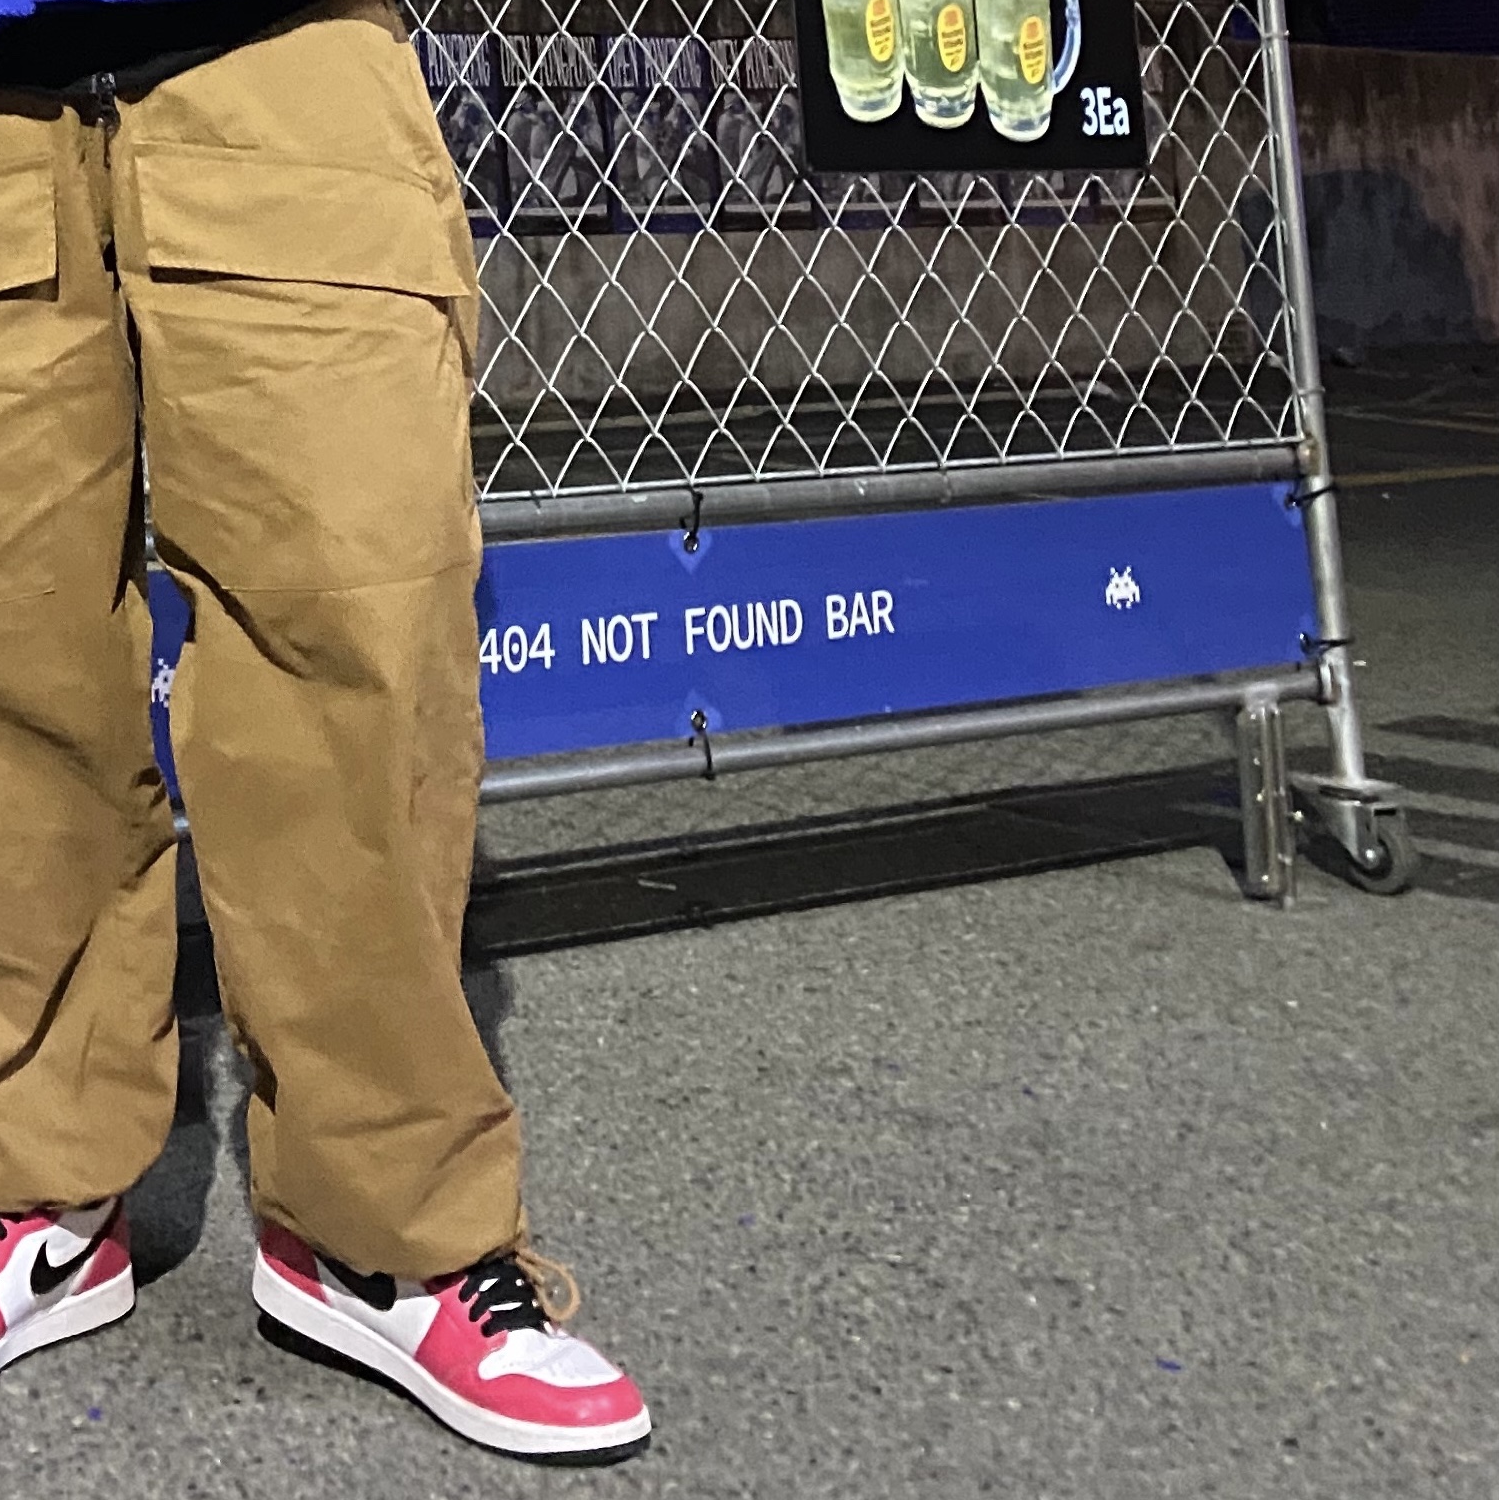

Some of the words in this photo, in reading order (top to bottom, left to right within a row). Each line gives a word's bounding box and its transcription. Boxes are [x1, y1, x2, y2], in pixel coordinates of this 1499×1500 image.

[1080, 87, 1131, 136] 3Ea
[479, 622, 556, 675] 404
[581, 612, 658, 666] NOT
[685, 599, 803, 654] FOUND
[825, 588, 895, 640] BAR
